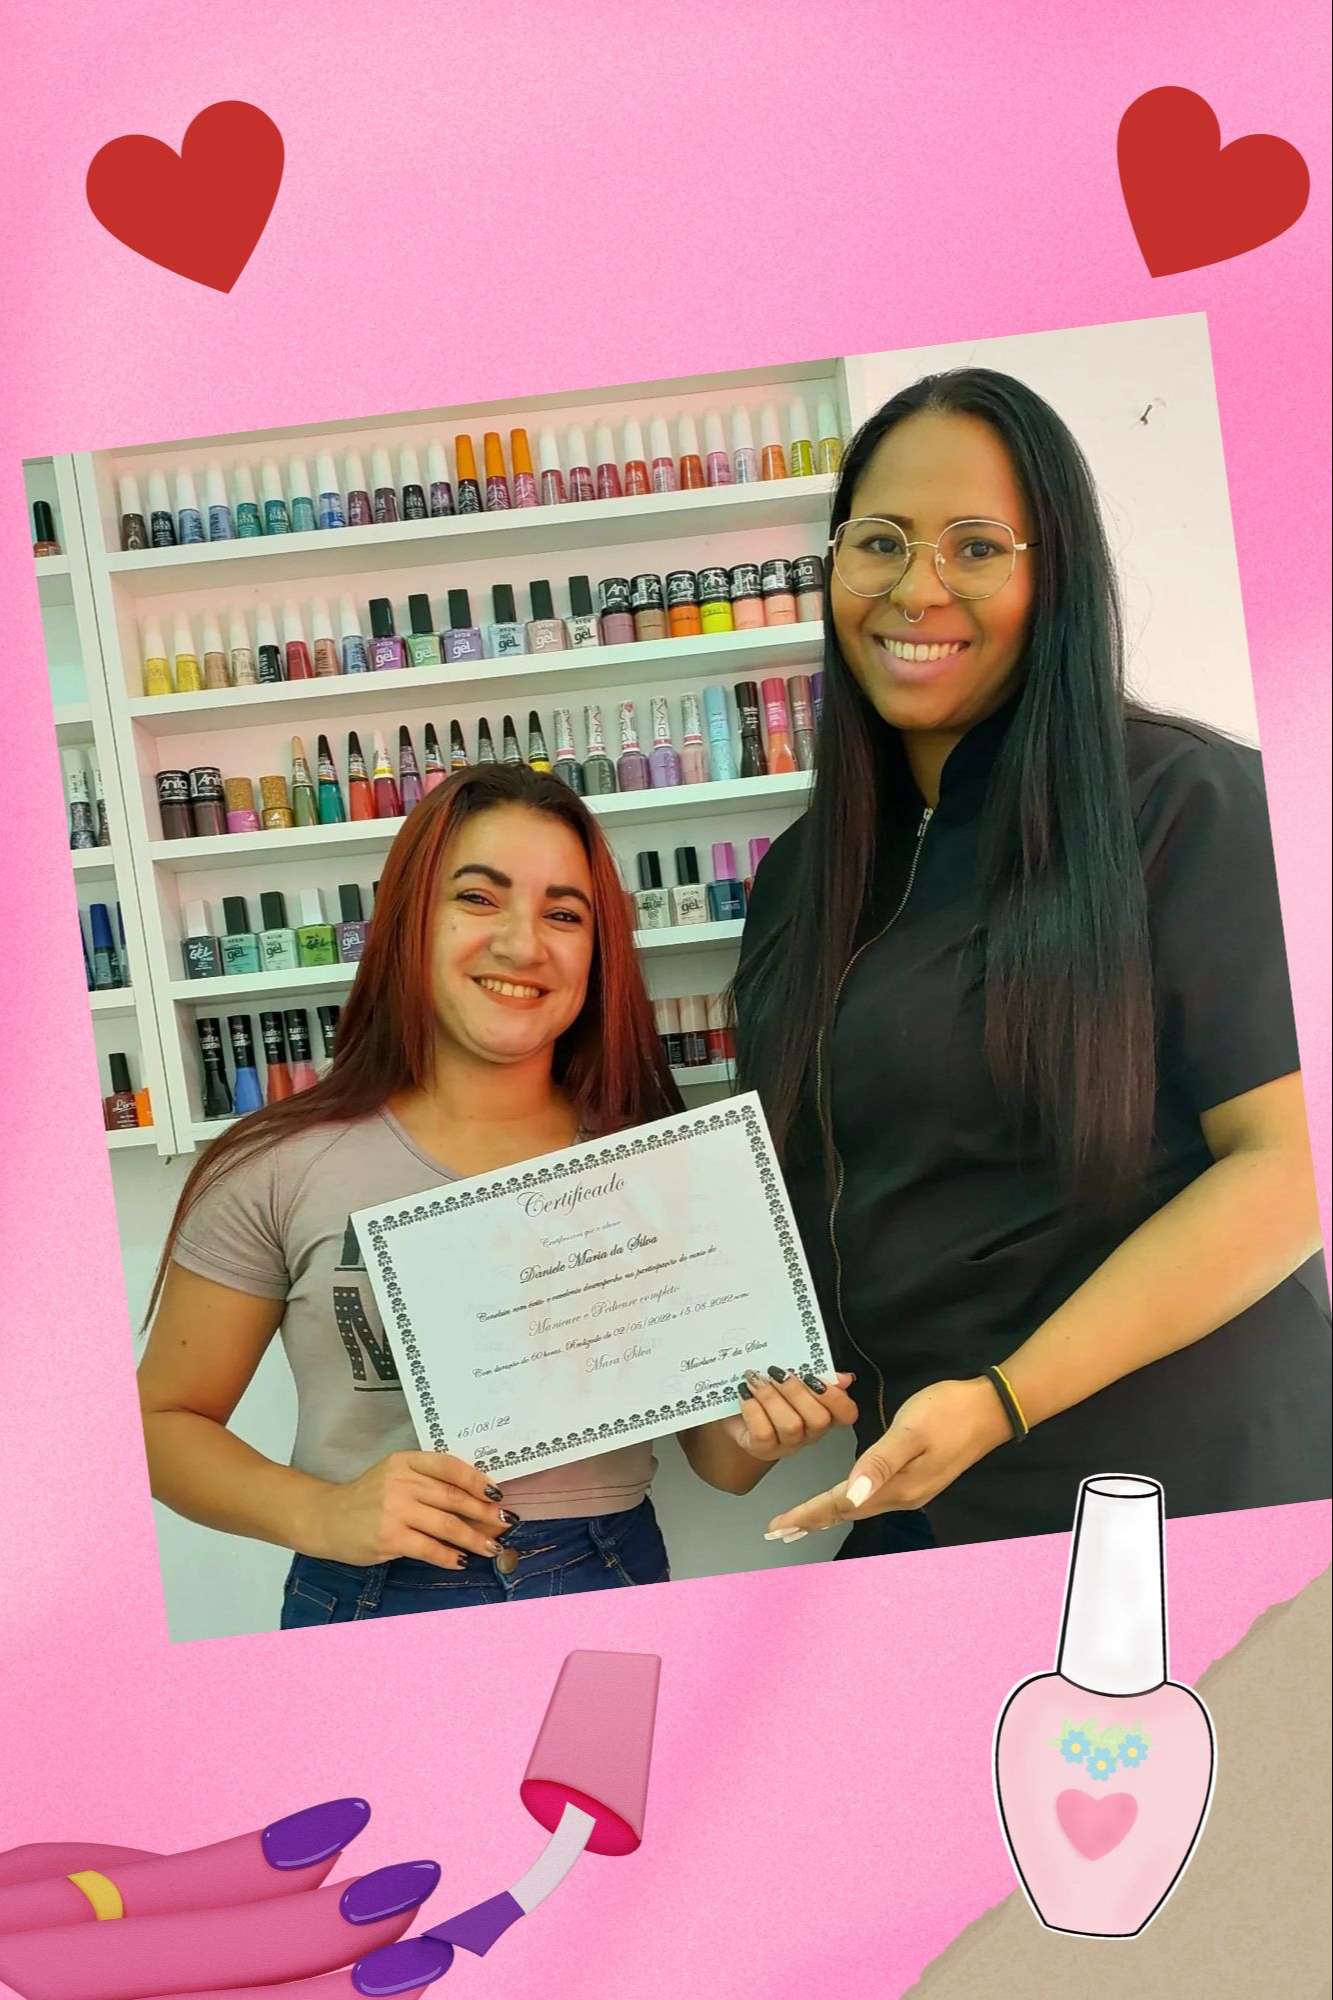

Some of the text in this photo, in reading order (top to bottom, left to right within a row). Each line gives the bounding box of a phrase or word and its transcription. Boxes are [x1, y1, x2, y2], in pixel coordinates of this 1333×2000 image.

[498, 636, 520, 652] gel
[573, 628, 596, 645] gel
[376, 649, 399, 667] gel
[452, 642, 475, 658] gel
[680, 899, 703, 915] gel
[342, 932, 365, 951] gel
[226, 946, 249, 962] gel
[266, 943, 289, 958] gel
[516, 1172, 624, 1217] Certificado
[519, 1260, 566, 1284] Daniele
[567, 1248, 608, 1269] Maria
[528, 1315, 581, 1336] Manicure
[590, 1298, 638, 1318] Pedicure
